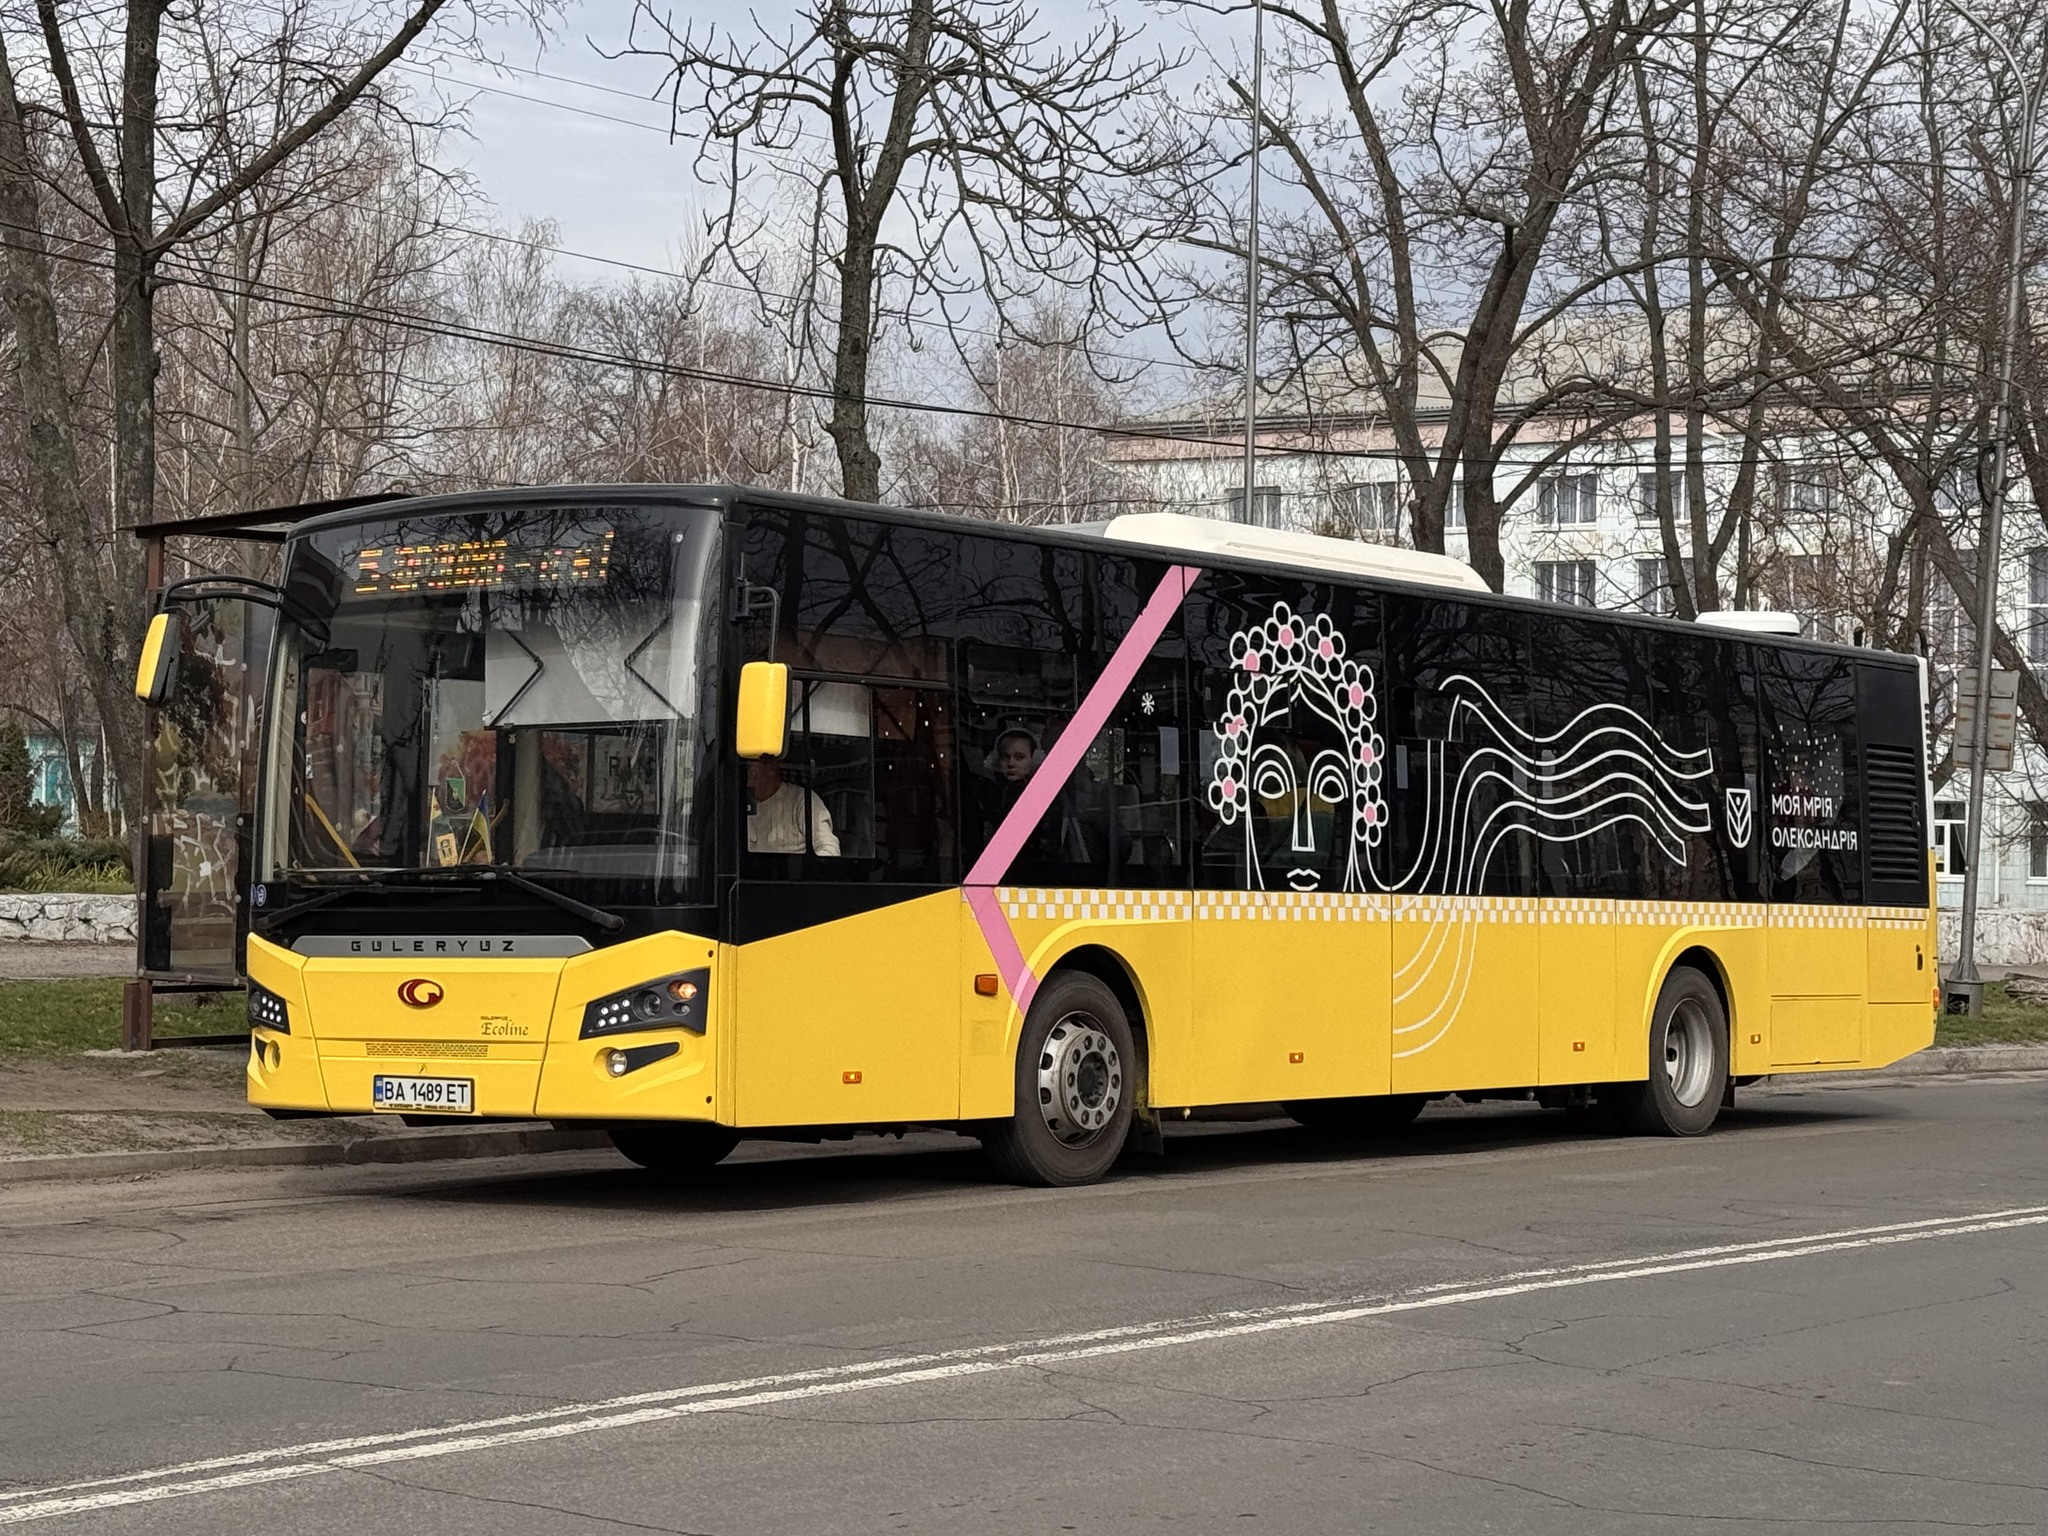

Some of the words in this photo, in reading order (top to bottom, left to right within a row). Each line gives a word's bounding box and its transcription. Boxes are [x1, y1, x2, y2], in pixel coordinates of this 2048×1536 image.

[1771, 793, 1801, 816] МОЯ
[1803, 796, 1833, 818] МРІЯ
[1772, 826, 1858, 851] ОЛЕКСАНДРІЯ
[481, 1020, 529, 1036] Ecoline
[384, 1081, 405, 1101] BA
[410, 1082, 443, 1103] 1489
[446, 1083, 468, 1103] ET
